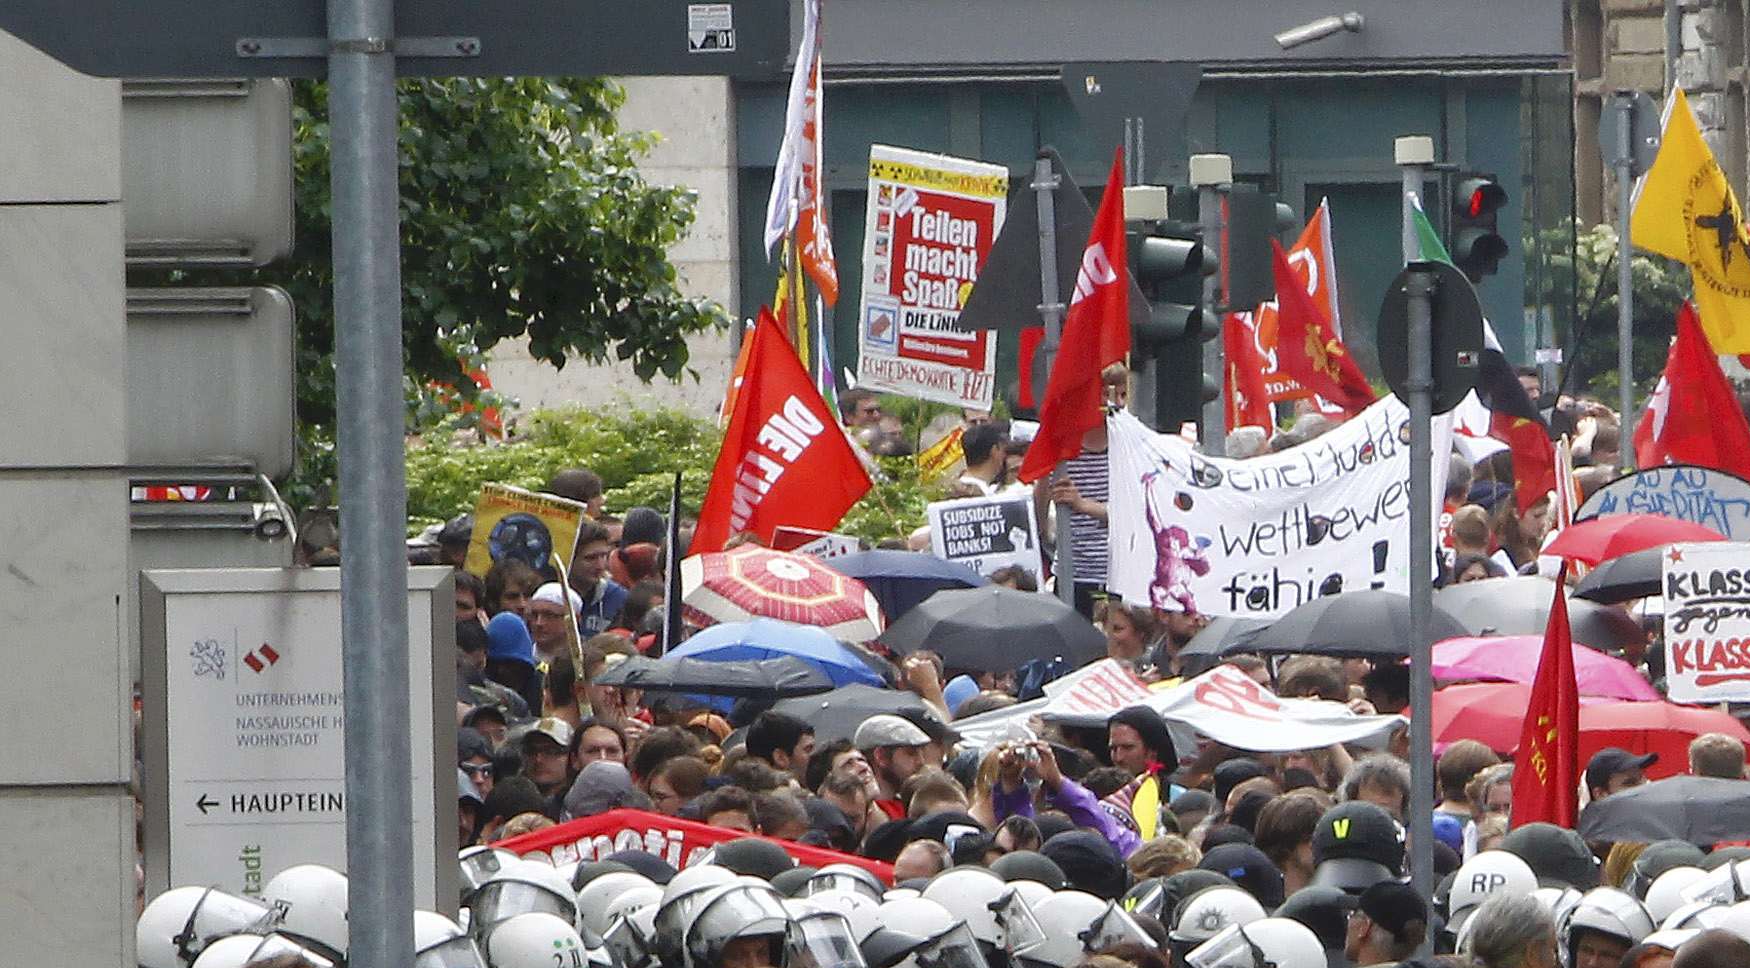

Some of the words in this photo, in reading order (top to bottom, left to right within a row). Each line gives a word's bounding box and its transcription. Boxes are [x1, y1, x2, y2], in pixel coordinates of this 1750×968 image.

[720, 31, 732, 47] 01
[911, 205, 977, 248] Teilen
[905, 243, 978, 282] macht
[901, 270, 959, 311] Spaß
[905, 311, 928, 329] DIE
[757, 394, 825, 463] DIE
[943, 505, 1003, 526] SUBSIDIZE
[946, 525, 975, 541] JOBS
[981, 520, 1006, 535] NOT
[236, 717, 328, 729] NASSAUISCHE
[236, 733, 319, 747] WOHNSTADT
[231, 793, 343, 812] HAUPTEIN
[1333, 818, 1349, 838] V
[1471, 872, 1506, 894] RP
